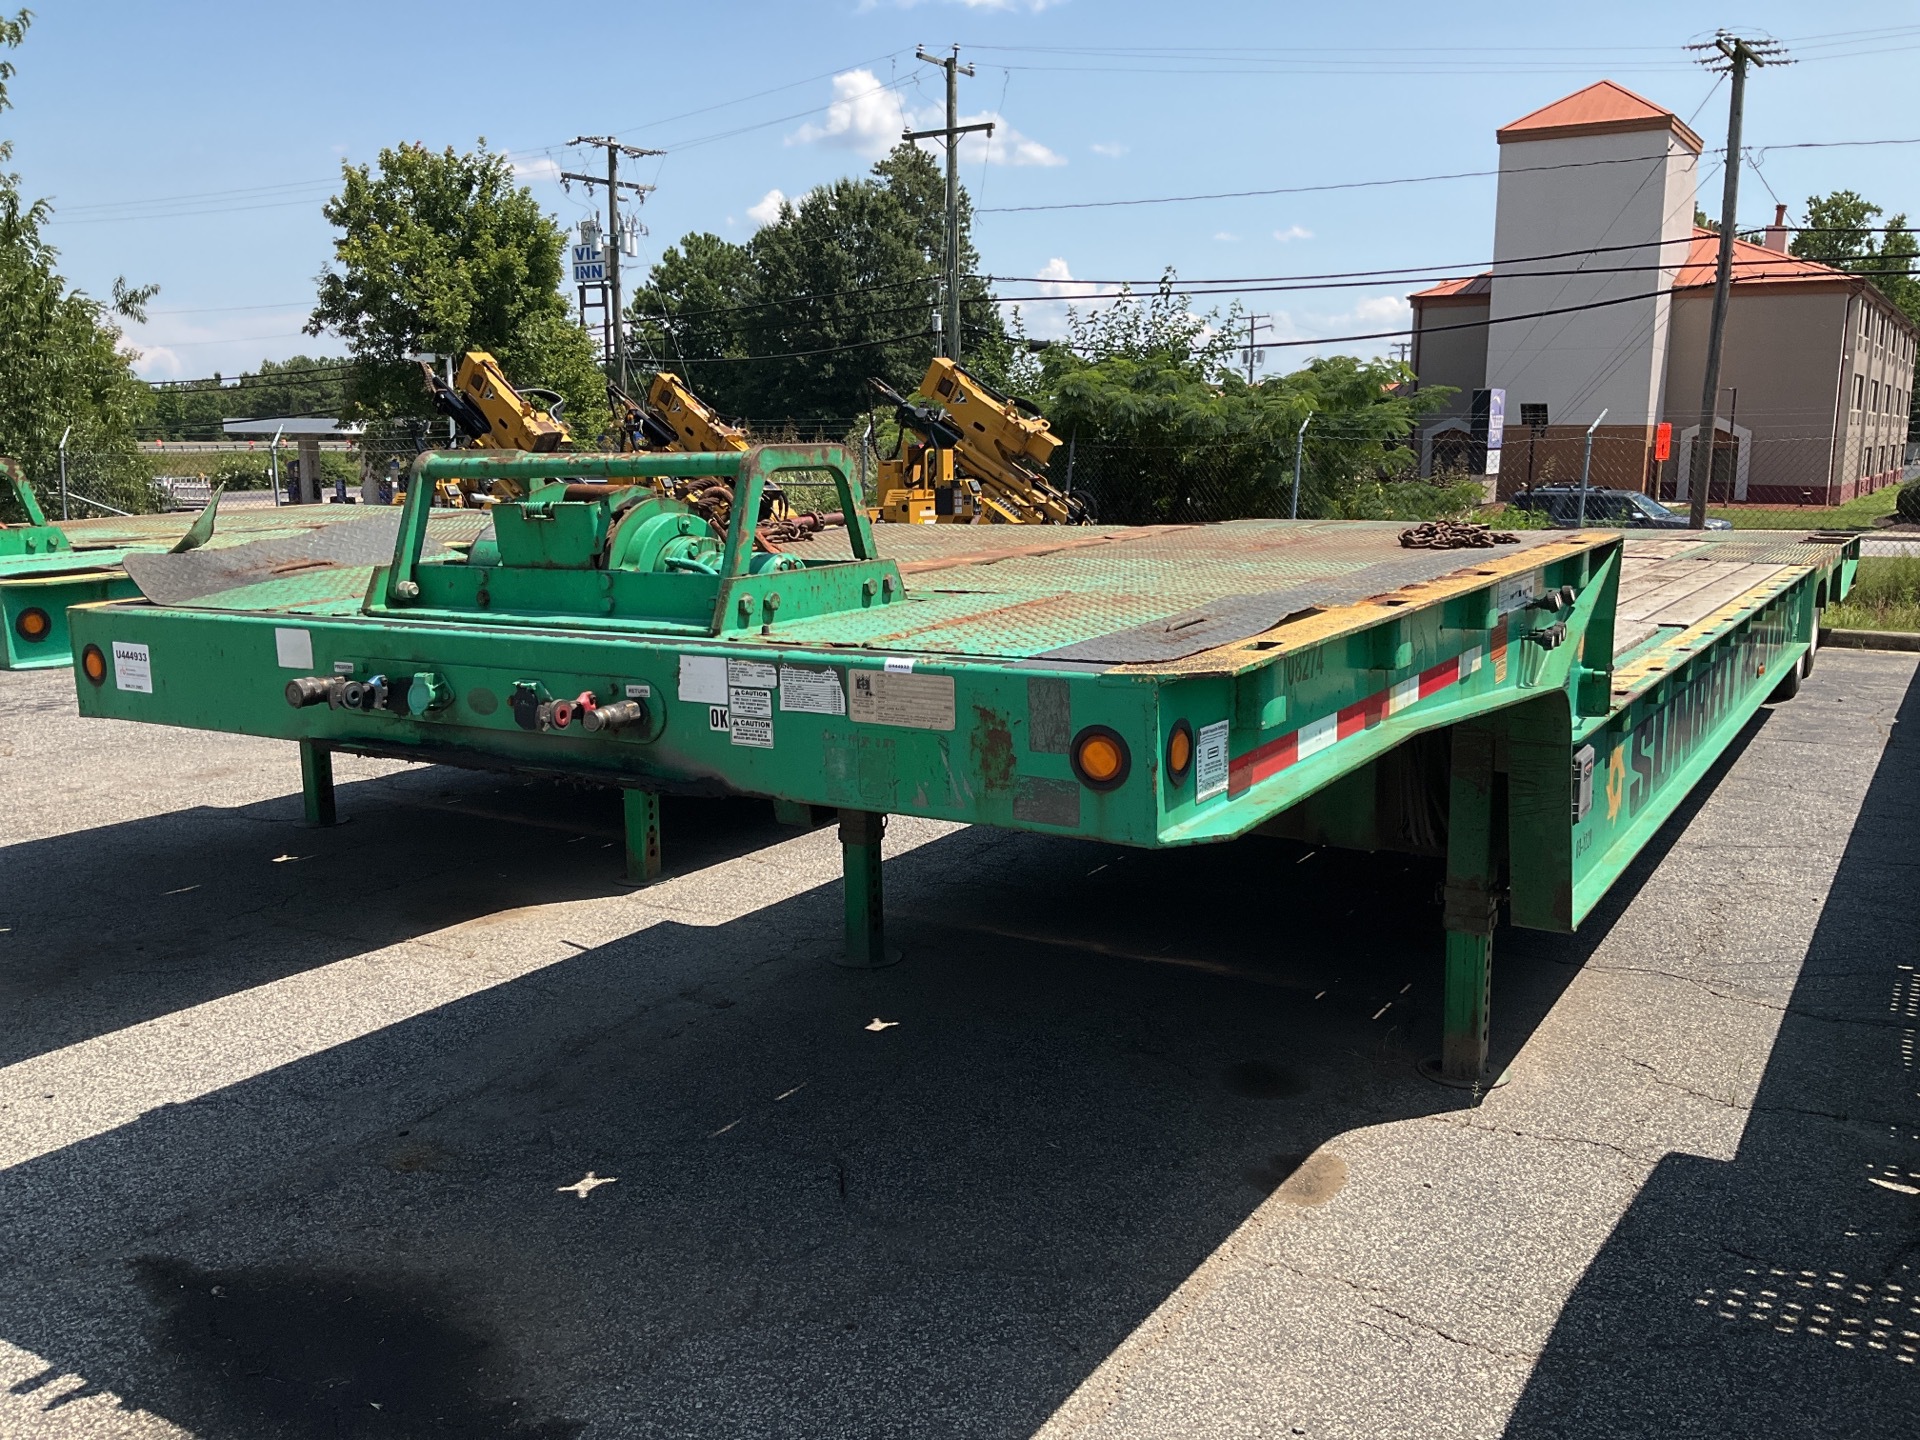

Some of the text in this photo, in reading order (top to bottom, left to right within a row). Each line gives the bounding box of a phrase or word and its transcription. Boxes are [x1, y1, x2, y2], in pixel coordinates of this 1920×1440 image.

[576, 264, 603, 280] INN
[116, 650, 147, 662] U444933
[741, 689, 768, 698] CAUTION
[710, 708, 729, 728] OK
[740, 719, 771, 729] CAUTION
